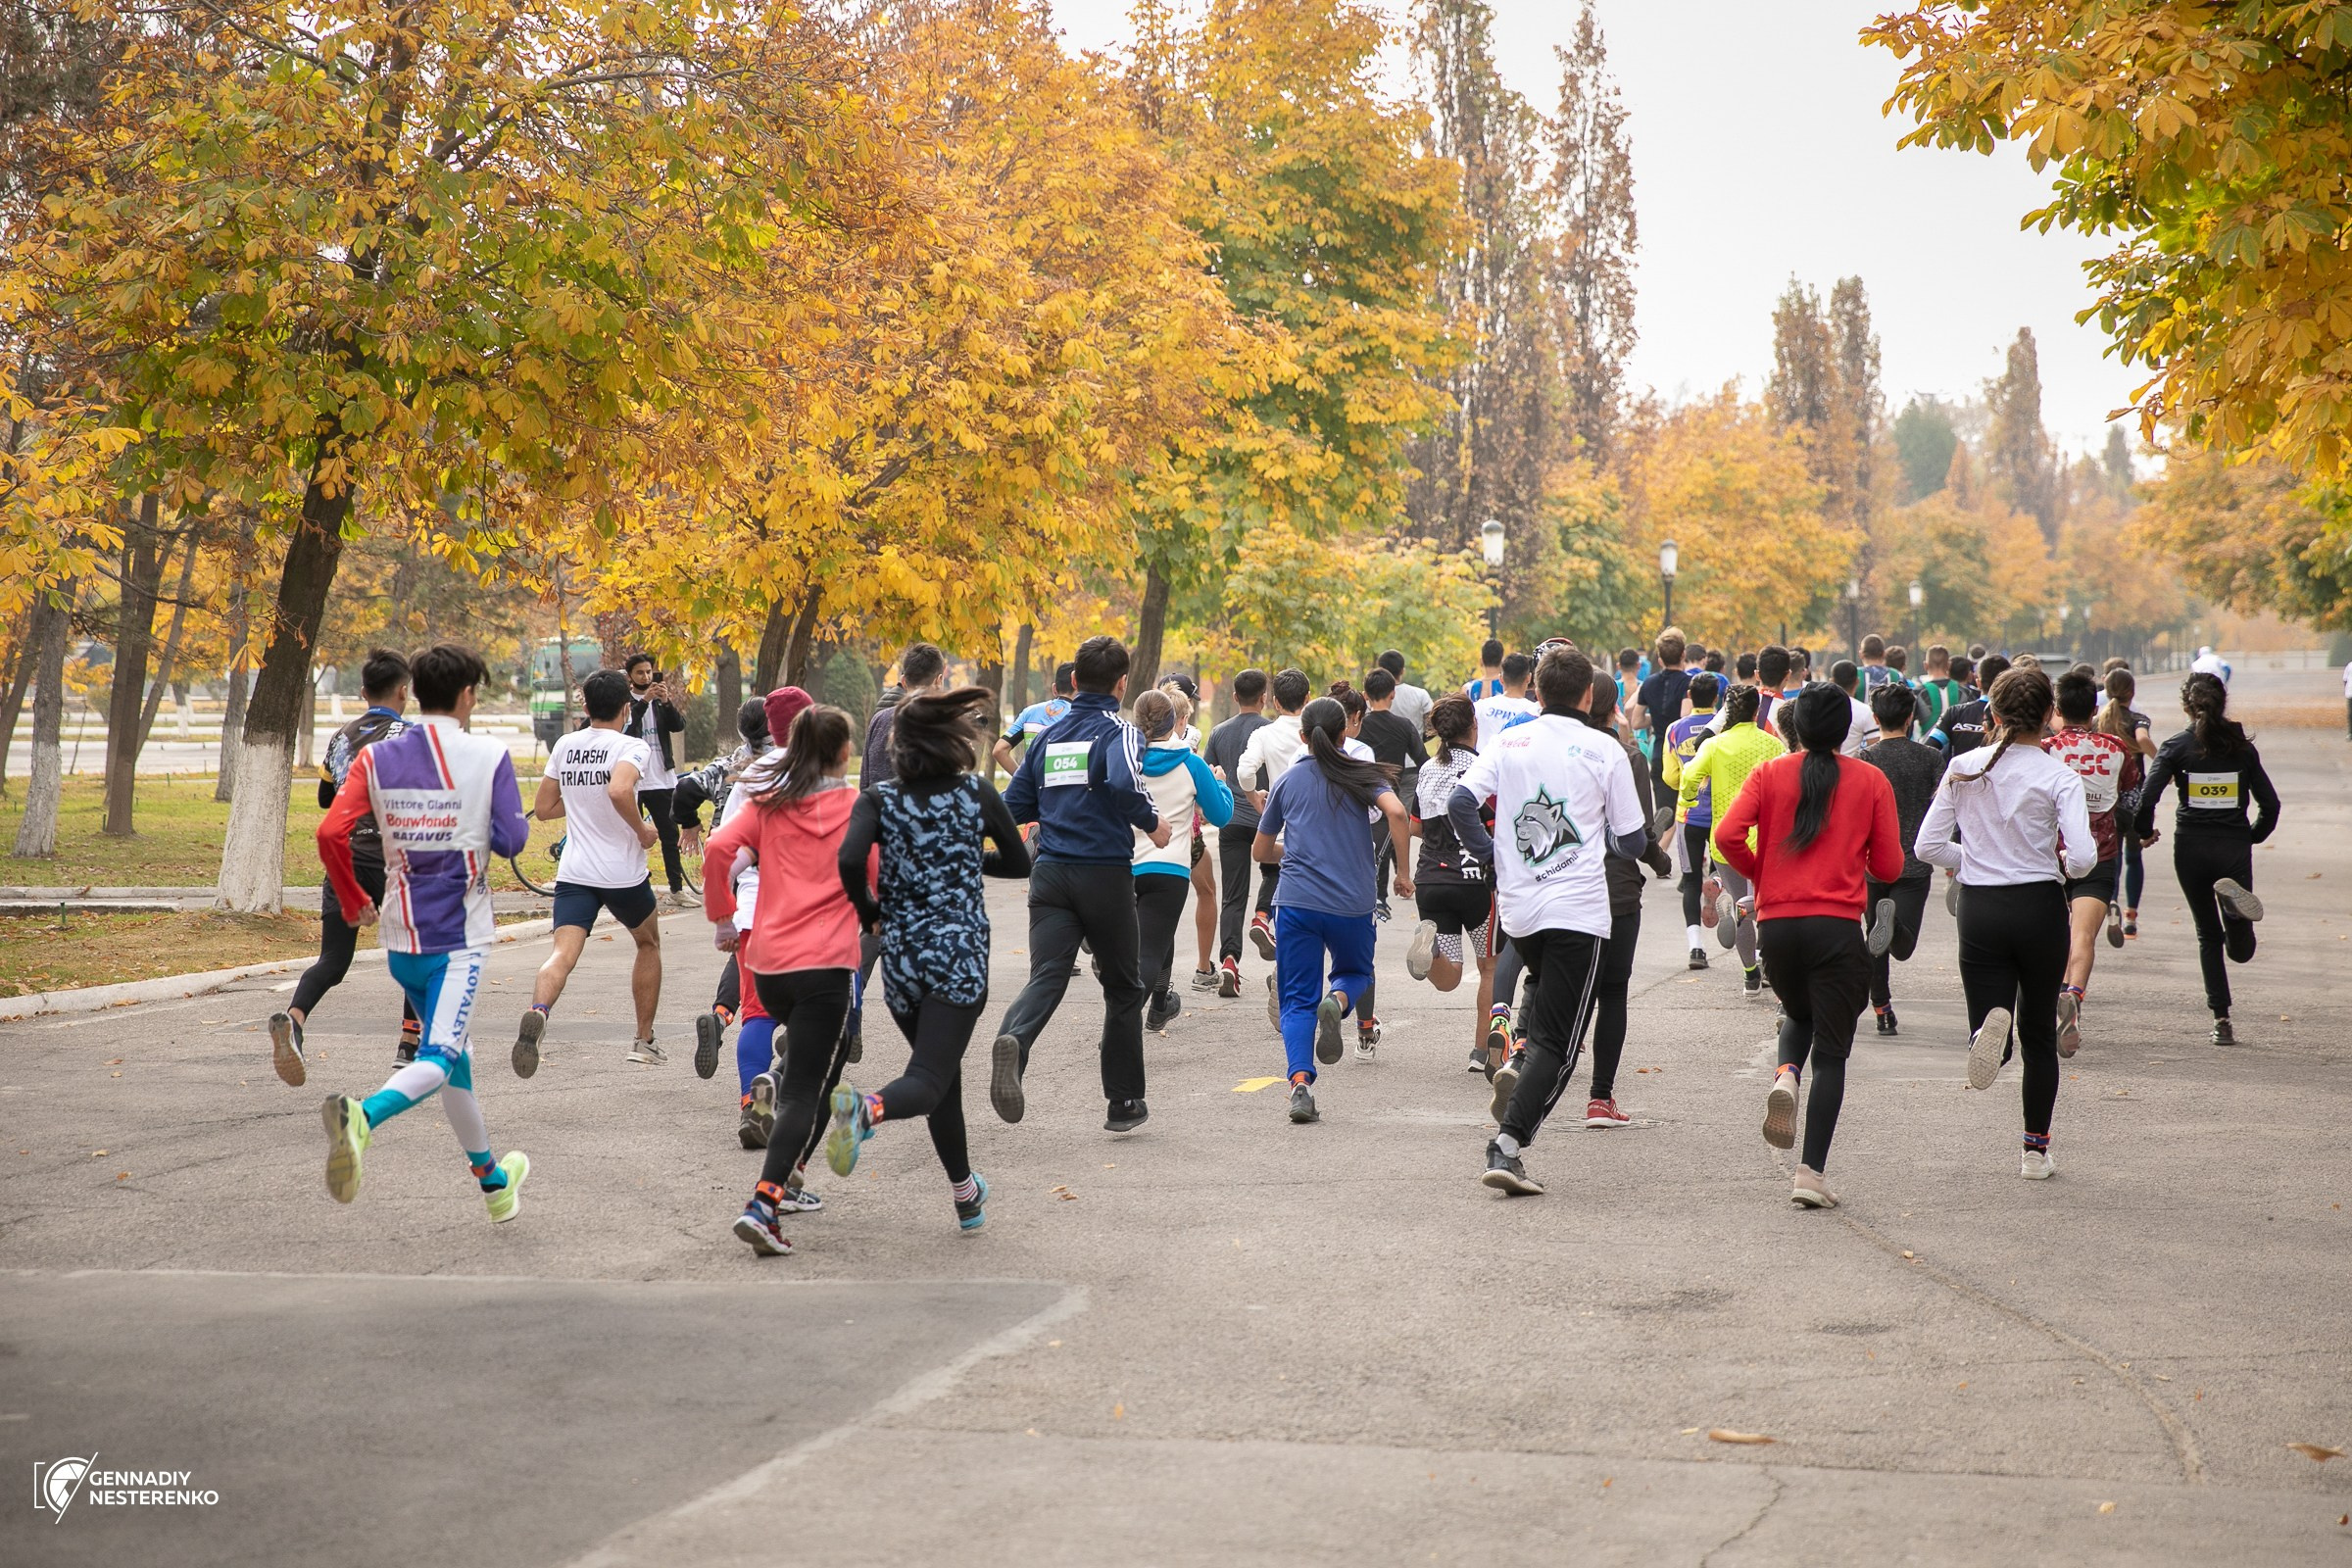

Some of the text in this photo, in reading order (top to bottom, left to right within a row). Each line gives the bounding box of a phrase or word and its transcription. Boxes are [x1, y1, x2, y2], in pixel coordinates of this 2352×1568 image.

[1486, 708, 1516, 720] ЭРИ
[1053, 757, 1078, 770] 054
[561, 770, 612, 786] TRIATLON
[2200, 785, 2229, 796] 039
[383, 800, 462, 809] Vittore Gianni
[385, 813, 458, 828] Bouwfonds
[393, 832, 453, 842] BATAVUS
[451, 963, 480, 1041] KOVALEV
